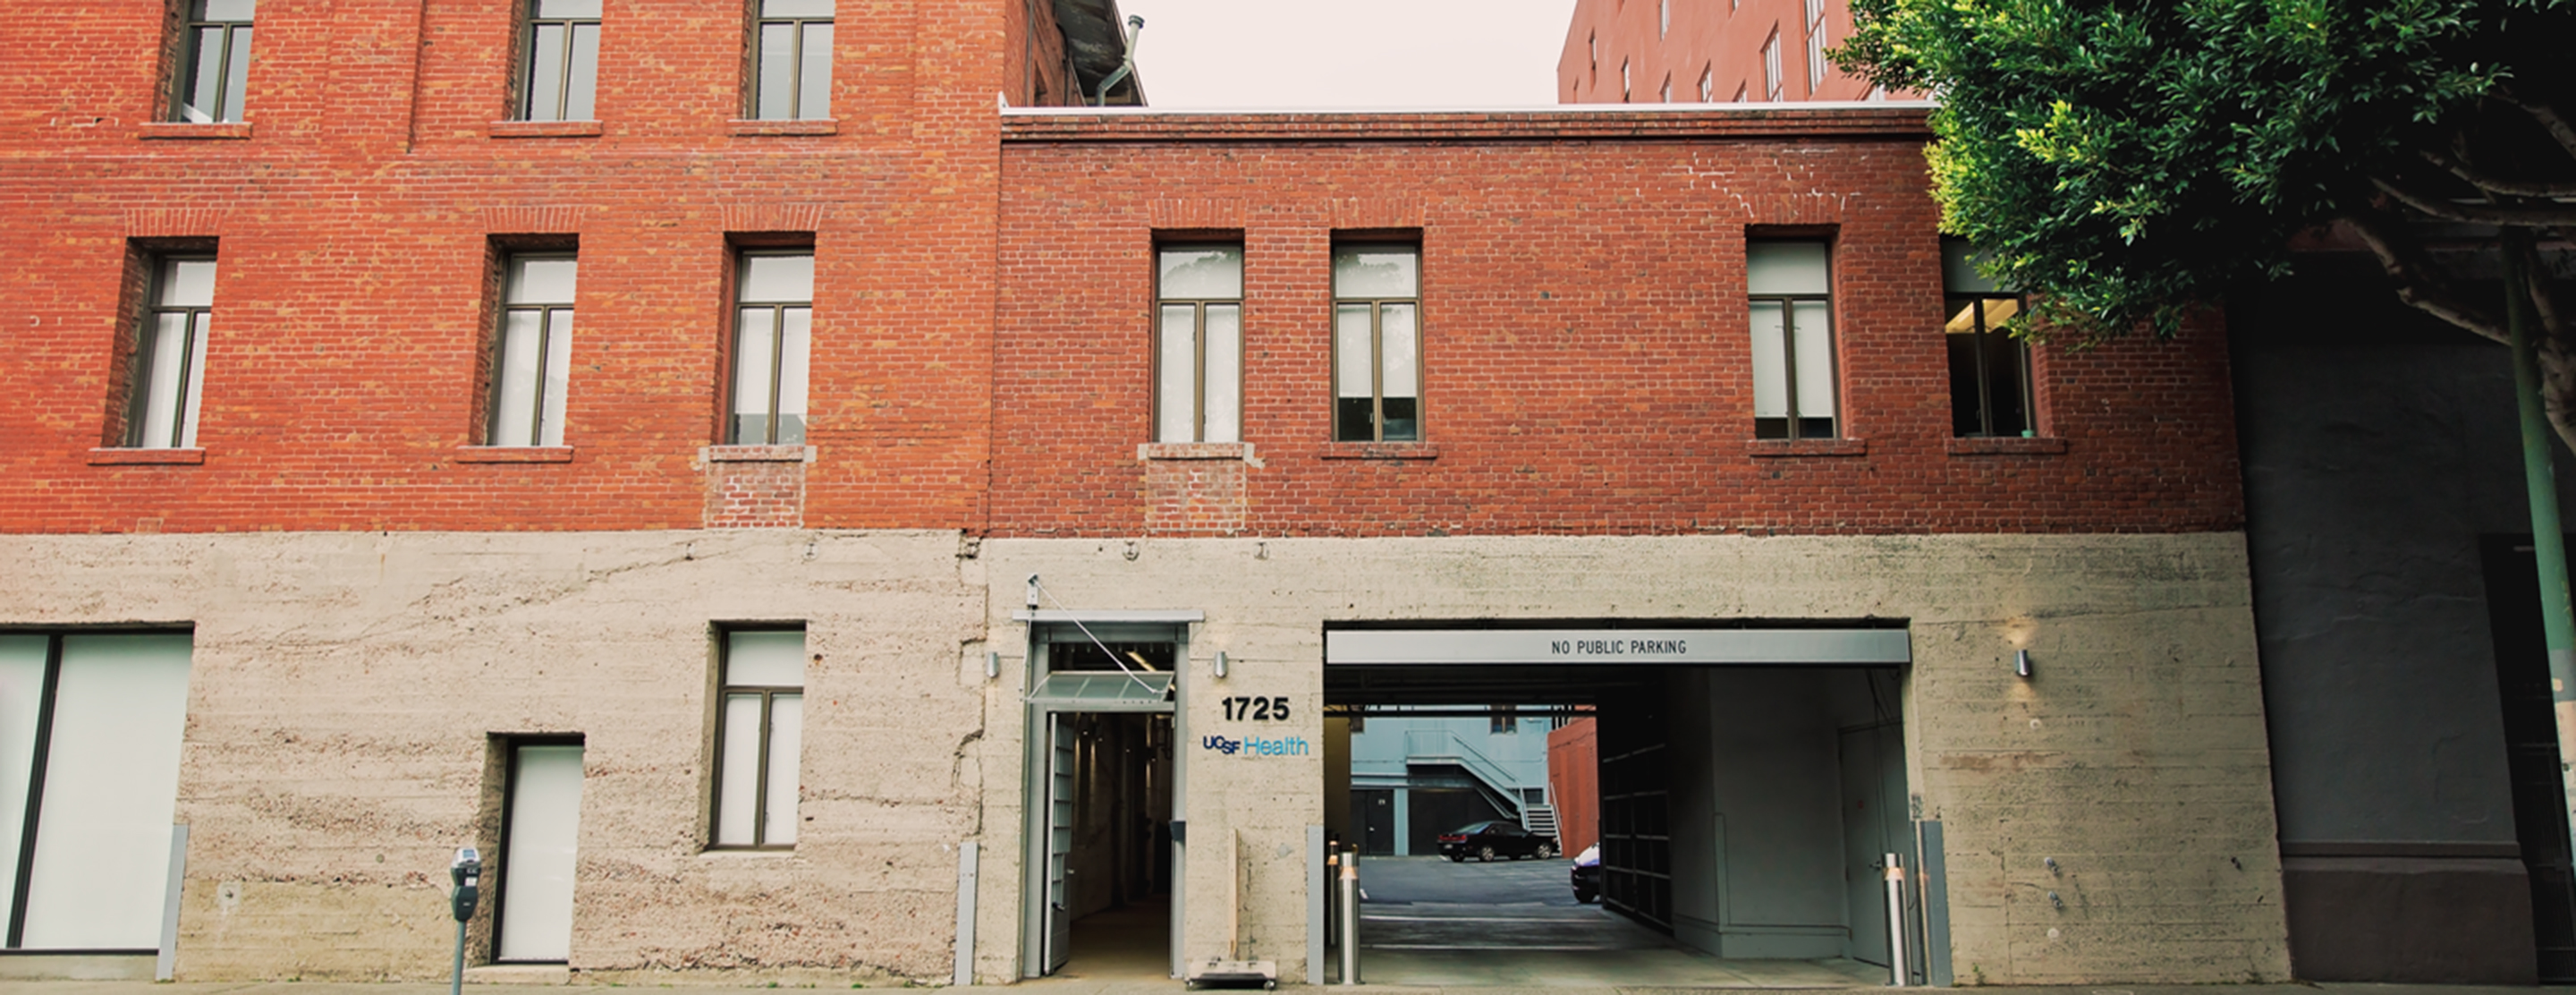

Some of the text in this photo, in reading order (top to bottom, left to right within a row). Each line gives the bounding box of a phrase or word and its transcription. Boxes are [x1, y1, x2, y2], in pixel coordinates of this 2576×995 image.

[1552, 640, 1686, 654] NO PUBLIC PARKING
[1222, 696, 1290, 721] 1725
[1203, 736, 1309, 755] UCSF Health
